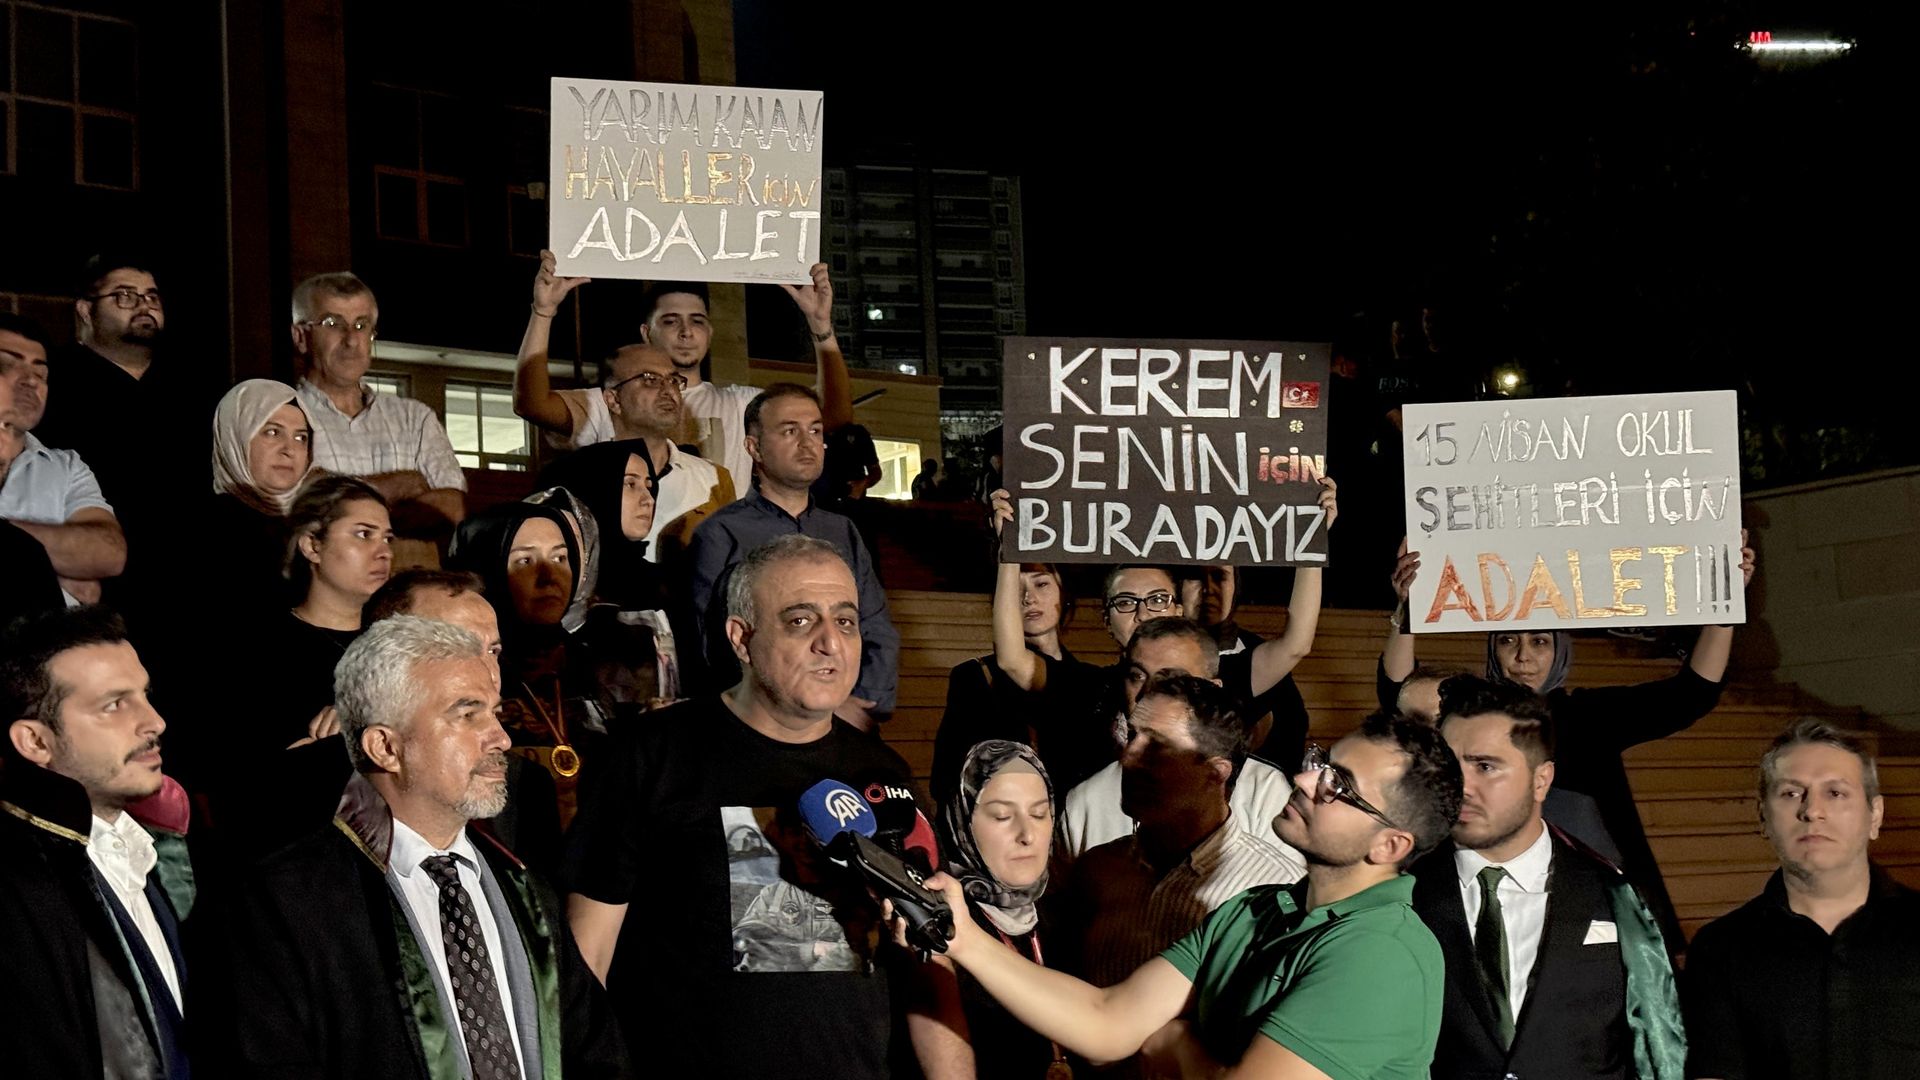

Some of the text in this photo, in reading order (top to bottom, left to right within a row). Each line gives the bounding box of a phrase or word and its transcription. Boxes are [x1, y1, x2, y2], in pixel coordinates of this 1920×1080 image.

[567, 86, 702, 147] YARIM
[564, 144, 760, 206] HAYALLER
[567, 207, 821, 265] ADALET
[1049, 347, 1283, 418] KEREM
[1019, 422, 1249, 496] SENİN
[1415, 408, 1713, 466] 15 NİSAN OKUL
[1643, 466, 1730, 525] İÇİN
[1018, 498, 1327, 563] BURADAYIZ
[831, 793, 868, 828] AA
[885, 785, 914, 800] İHA
